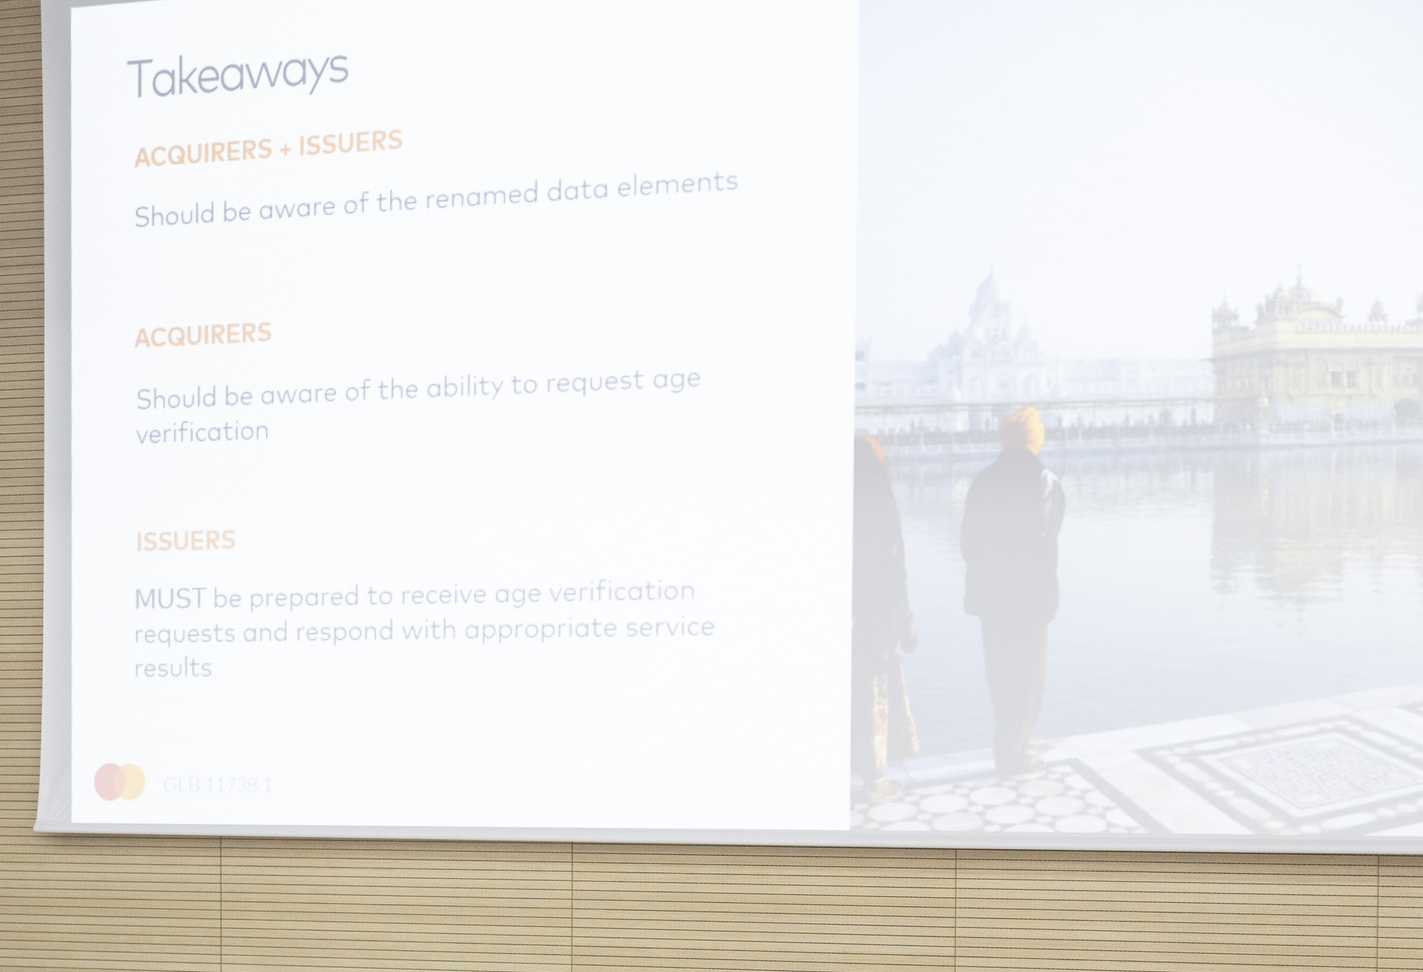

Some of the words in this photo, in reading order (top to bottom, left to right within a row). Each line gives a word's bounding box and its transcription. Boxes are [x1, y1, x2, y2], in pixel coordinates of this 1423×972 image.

[125, 54, 350, 99] Takeaways
[134, 138, 273, 168] ACQUIRERS
[279, 143, 292, 157] +
[299, 128, 404, 157] ISSUERS
[134, 200, 215, 229] Should
[223, 200, 252, 223] be
[258, 200, 336, 221] aware
[343, 190, 370, 215] of
[376, 189, 418, 213] the
[426, 179, 539, 209] renamed
[546, 178, 608, 202] data
[617, 171, 739, 198] elements
[134, 321, 273, 349] ACQUIRERS
[136, 385, 217, 411] Should
[225, 384, 253, 407] be
[260, 387, 337, 406] aware
[345, 377, 371, 402] of
[377, 377, 419, 401] the
[426, 374, 504, 401] ability
[511, 375, 538, 395] to
[546, 370, 644, 397] request
[652, 371, 701, 394] age
[135, 420, 269, 445] verification
[137, 529, 236, 552] ISSUERS
[135, 587, 207, 610] MUST
[213, 586, 242, 609] be
[250, 583, 359, 613] prepared
[367, 586, 393, 606] to
[401, 584, 487, 605] receive
[495, 587, 542, 609] age
[549, 578, 695, 603] verification
[135, 624, 236, 648] requests
[243, 619, 288, 643] and
[296, 618, 394, 646] respond
[401, 617, 456, 640] with
[464, 618, 617, 644] appropriate
[626, 616, 715, 638] service
[135, 655, 212, 678] results
[163, 777, 200, 792] GLB
[207, 777, 271, 793] 11738.1
